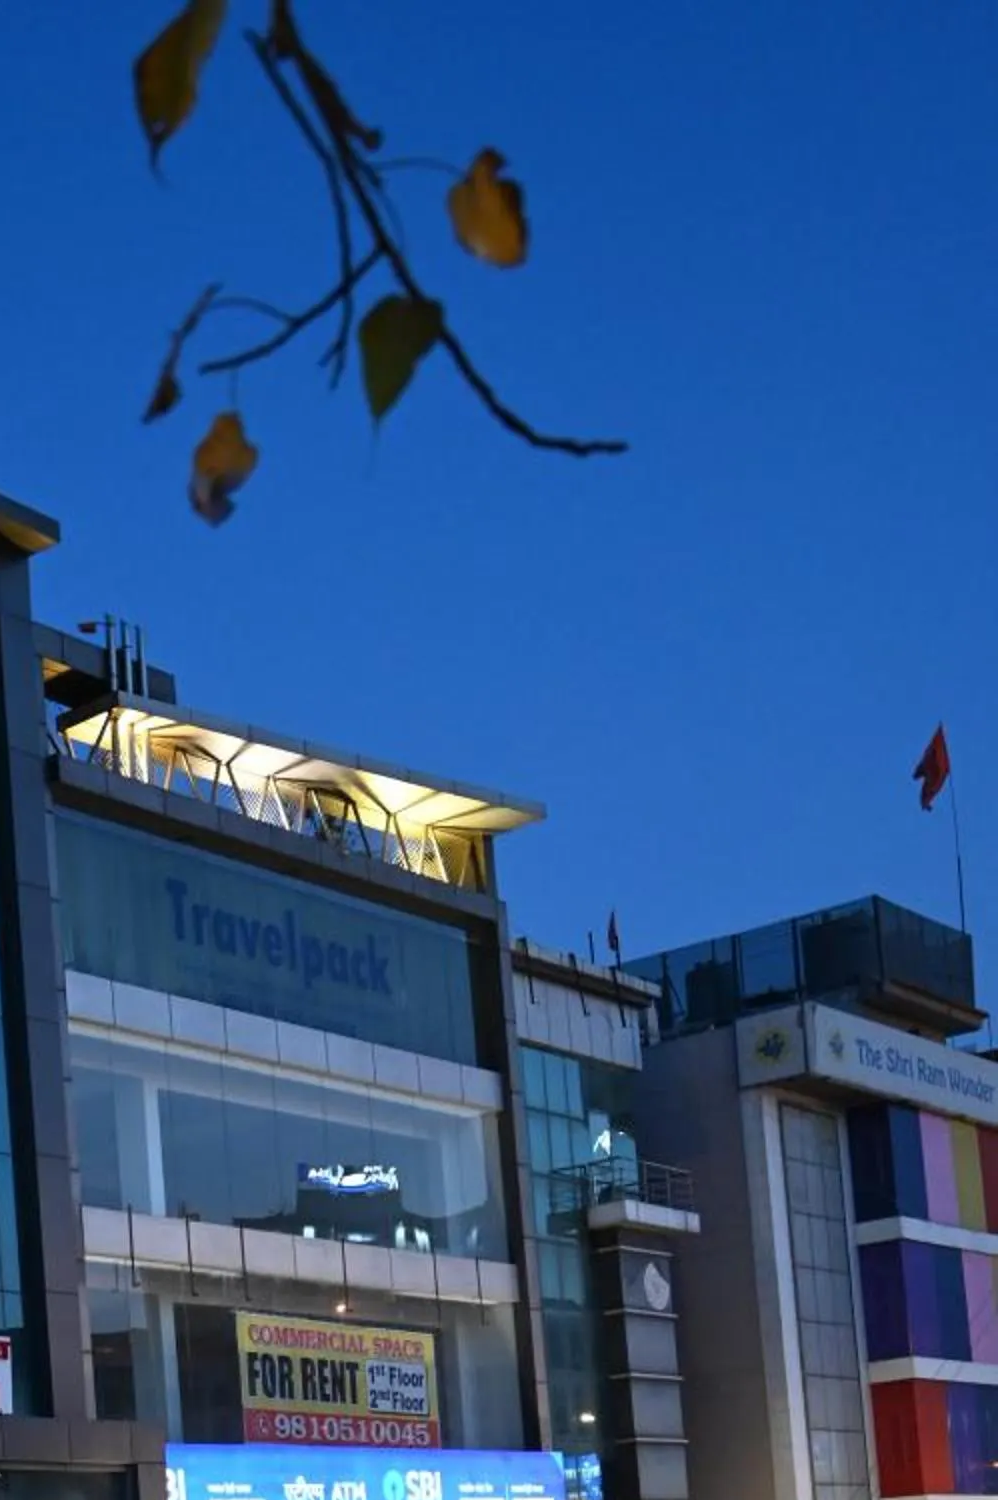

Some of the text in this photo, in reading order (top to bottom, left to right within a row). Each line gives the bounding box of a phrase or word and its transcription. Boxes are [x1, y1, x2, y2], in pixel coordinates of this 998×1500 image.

[164, 877, 392, 994] Travelpack
[855, 1038, 883, 1071] The
[885, 1047, 914, 1081] Shri
[917, 1057, 947, 1089] Ram
[248, 1323, 425, 1359] COMMERCIAL SPACE
[246, 1351, 360, 1405] FOR RENT
[368, 1364, 424, 1388] 1st Floor
[369, 1388, 424, 1412] 2nd Floor
[274, 1414, 430, 1446] 9810510045
